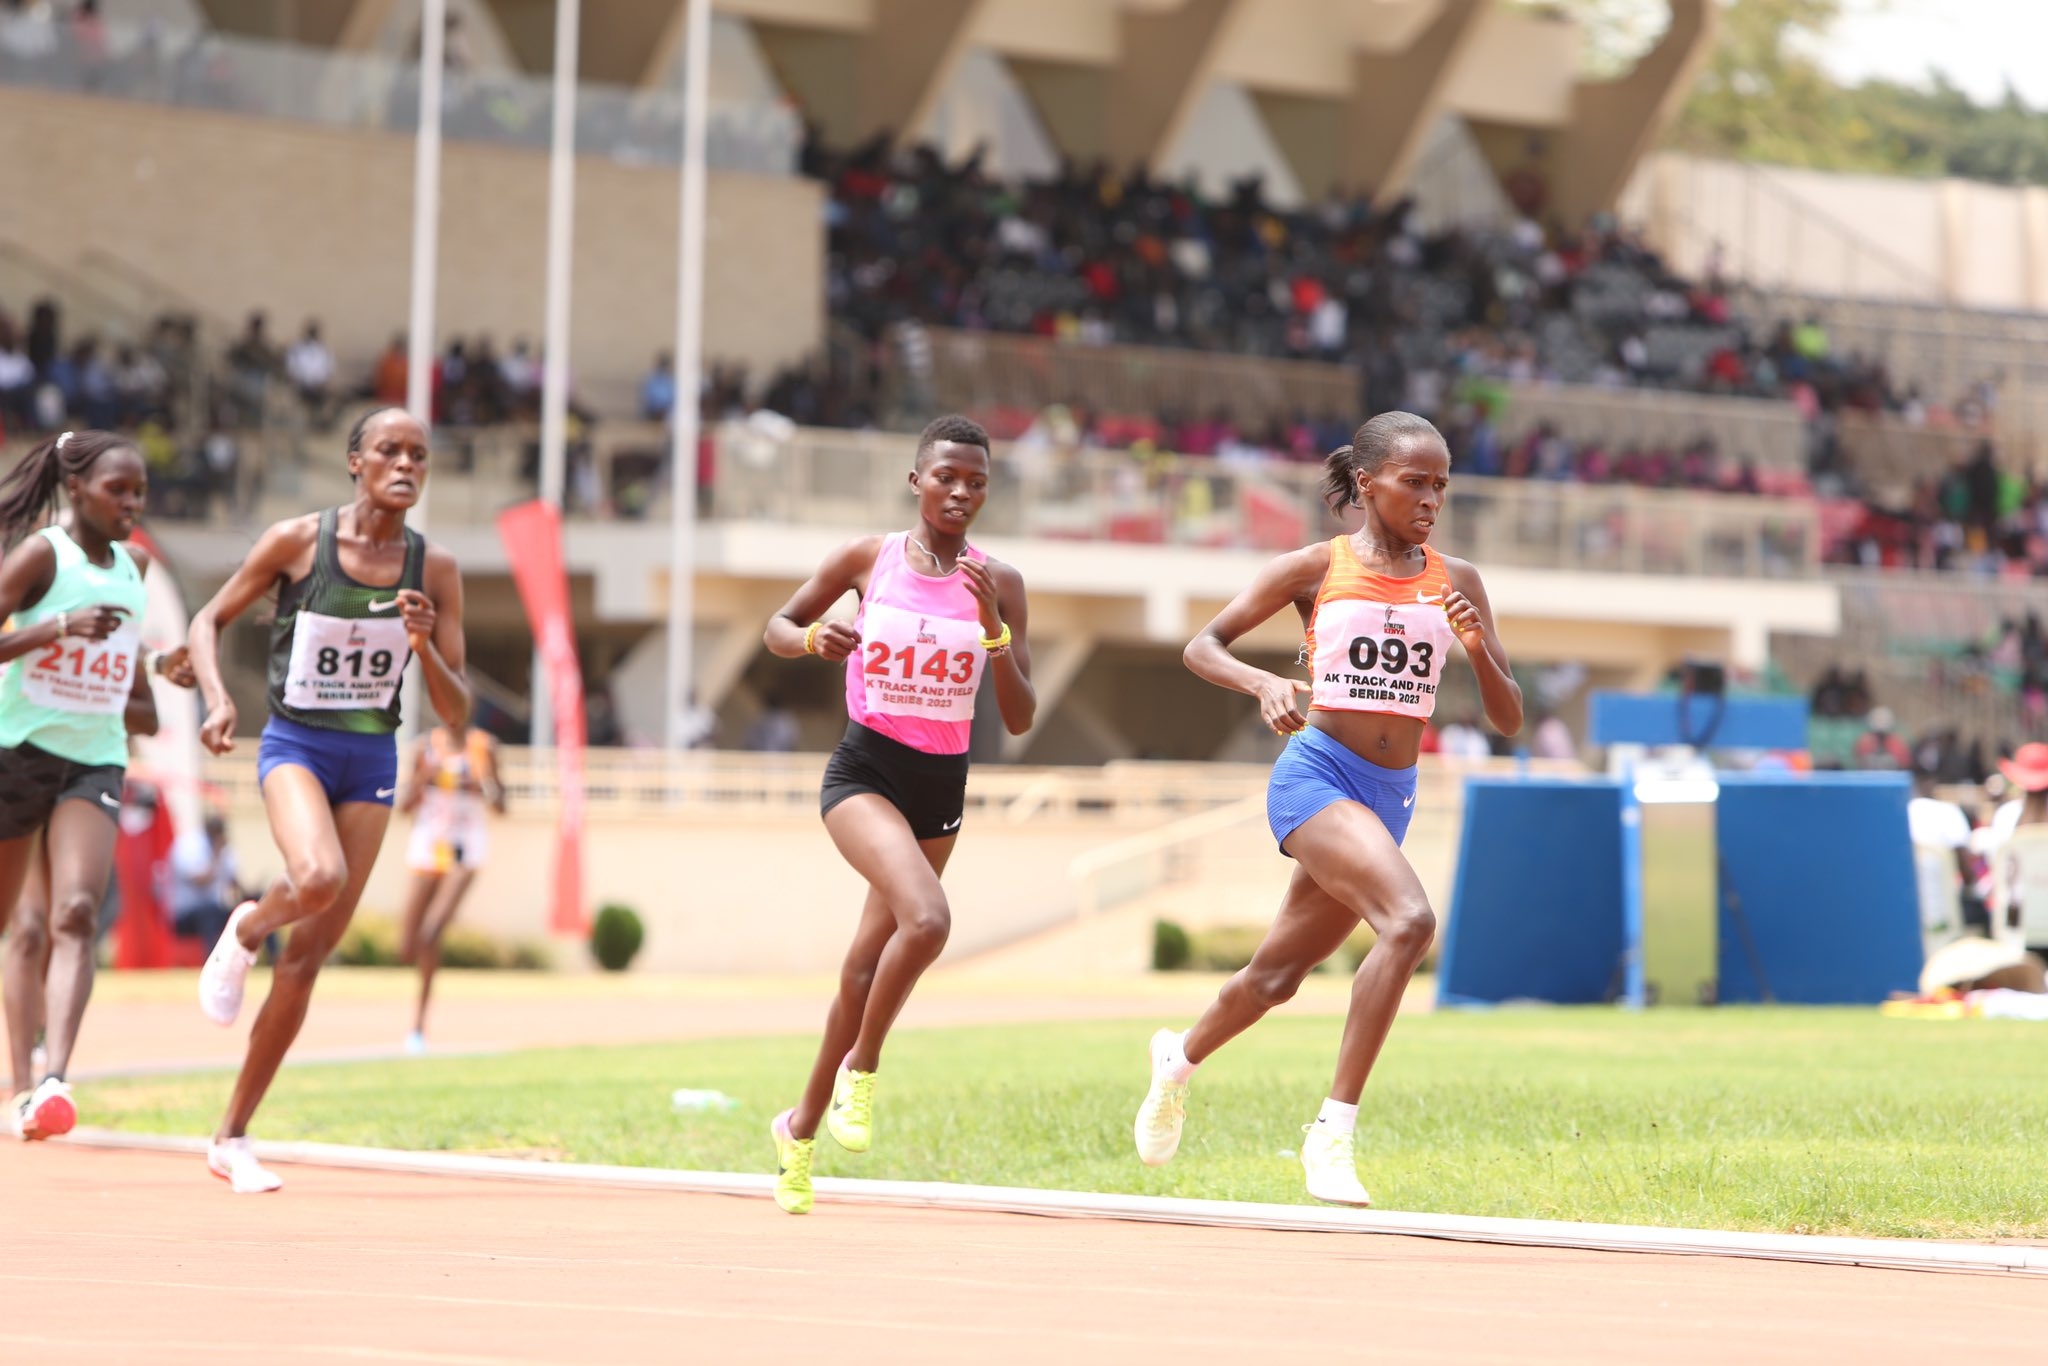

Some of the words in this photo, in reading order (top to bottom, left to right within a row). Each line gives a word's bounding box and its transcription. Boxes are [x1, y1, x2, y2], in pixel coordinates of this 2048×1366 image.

[37, 641, 127, 682] 2145
[317, 646, 393, 677] 819
[865, 641, 974, 684] 2143
[1349, 636, 1433, 678] 093
[878, 680, 917, 693] TRACK
[921, 686, 945, 696] AND
[948, 686, 973, 696] FIELD
[1325, 674, 1340, 683] AK
[1344, 675, 1388, 687] TRACK
[1390, 680, 1415, 690] AND
[883, 692, 924, 706] SERIES
[927, 698, 952, 708] 2023
[1350, 688, 1396, 700] SERIES
[1399, 693, 1420, 704] 2023
